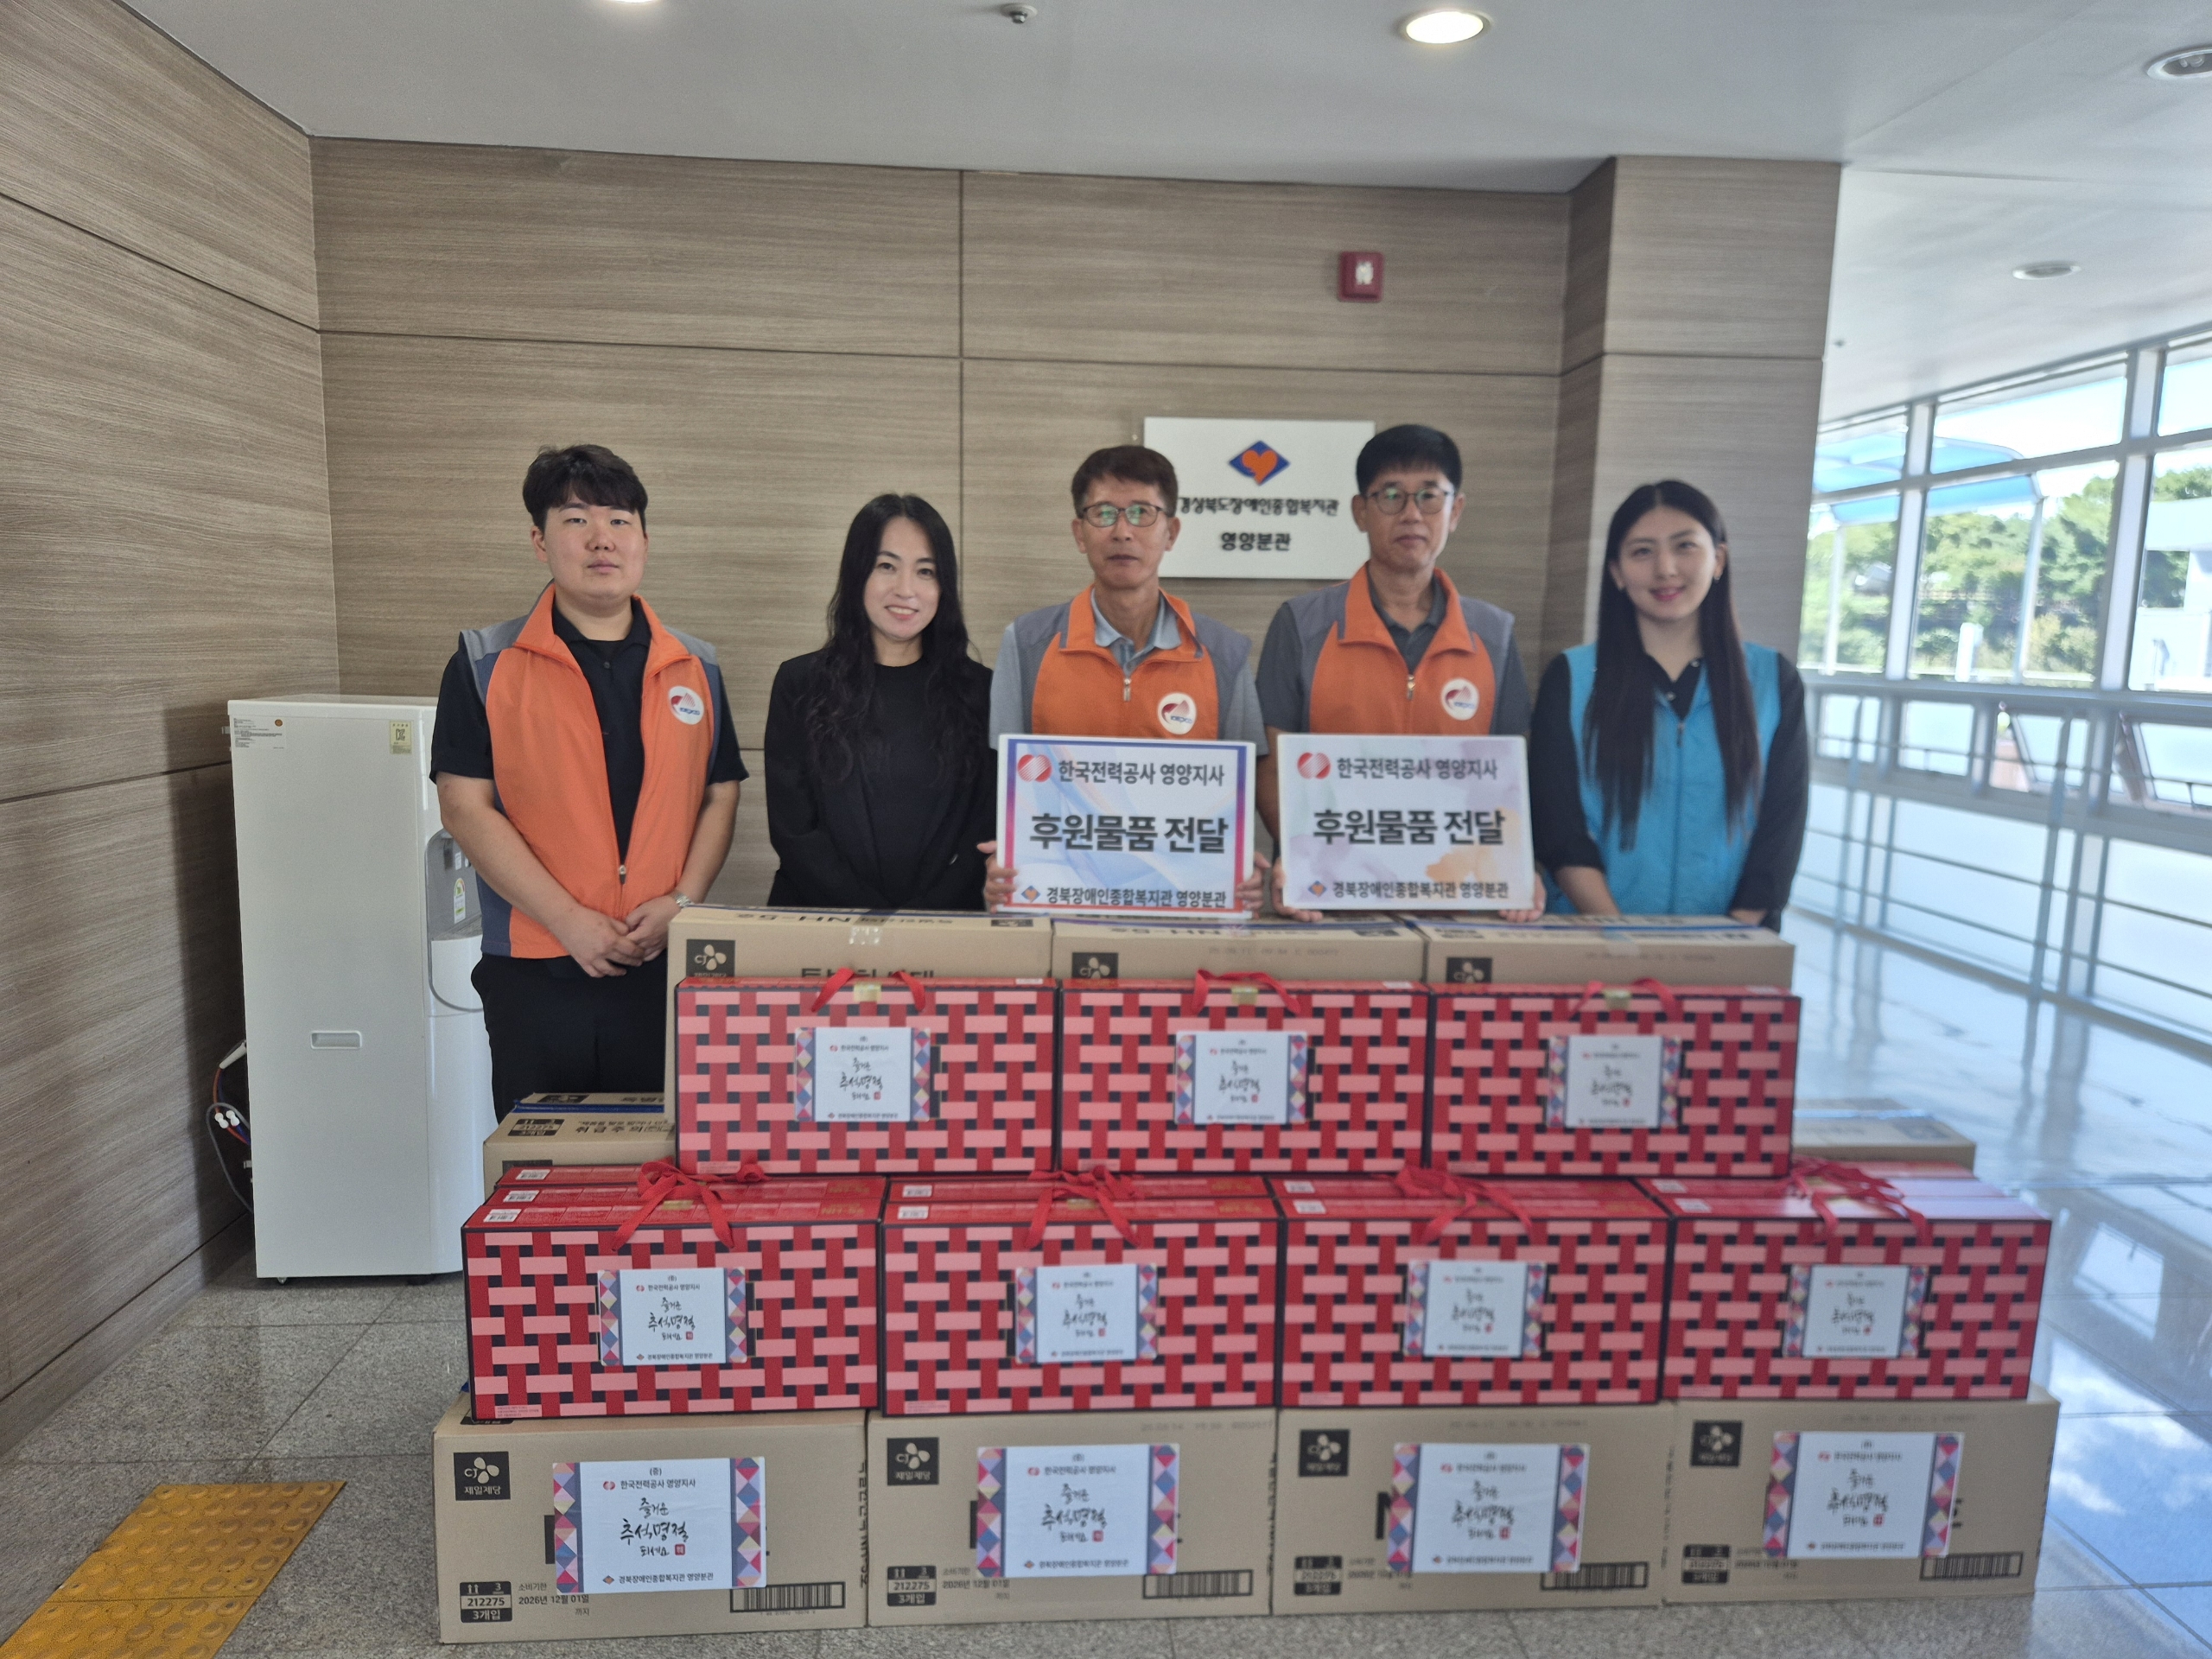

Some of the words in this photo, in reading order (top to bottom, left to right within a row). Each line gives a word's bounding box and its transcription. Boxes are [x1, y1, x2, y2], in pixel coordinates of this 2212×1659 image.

[1220, 532, 1291, 551] 영양분관
[1058, 760, 1155, 784] 한국전력공사
[1160, 764, 1224, 786] 영양지사
[1338, 758, 1432, 779] 한국전력공사
[1436, 760, 1497, 779] 영양지사
[1030, 813, 1158, 852] 후원물품
[1164, 817, 1229, 853] 전달
[1314, 809, 1438, 845] 후원물품
[1445, 810, 1505, 845] 전달
[1333, 882, 1457, 899] 경북장애인종합복지관
[1459, 882, 1509, 899] 영양분관
[1046, 887, 1173, 906] 경북장애인종합복지관
[1176, 891, 1226, 908] 영양분관
[695, 955, 708, 965] CJ
[853, 1058, 871, 1071] 즐거운
[840, 1072, 883, 1091] 추석명절
[661, 1298, 682, 1313] 즐거운
[648, 1313, 696, 1332] 추석명절
[662, 1332, 682, 1341] 되세요
[895, 1453, 909, 1464] CJ
[464, 1468, 478, 1478] CJ
[650, 1467, 662, 1476] (증)
[895, 1471, 931, 1480] 제일제당
[1045, 1466, 1086, 1475] 한국전력공사
[1089, 1465, 1116, 1475] 영양지사
[620, 1480, 664, 1489] 한국전력공사
[666, 1478, 696, 1488] 영양지사
[464, 1486, 501, 1495] 제일제당
[1061, 1484, 1090, 1504] 즐거운
[639, 1497, 669, 1518] 즐거운
[1041, 1504, 1107, 1530] 추석명절
[620, 1519, 690, 1545] 추석명절
[640, 1546, 671, 1557] 되세요
[619, 1574, 685, 1585] 경북장애인종합복지관
[687, 1573, 714, 1581] 영양분관
[943, 1580, 970, 1589] 2026년
[893, 1581, 930, 1591] 212275
[467, 1598, 505, 1606] 212275
[518, 1596, 548, 1605] 2026년
[571, 1594, 589, 1604] 01일
[898, 1593, 925, 1605] 3개입
[473, 1610, 501, 1620] 3개입
